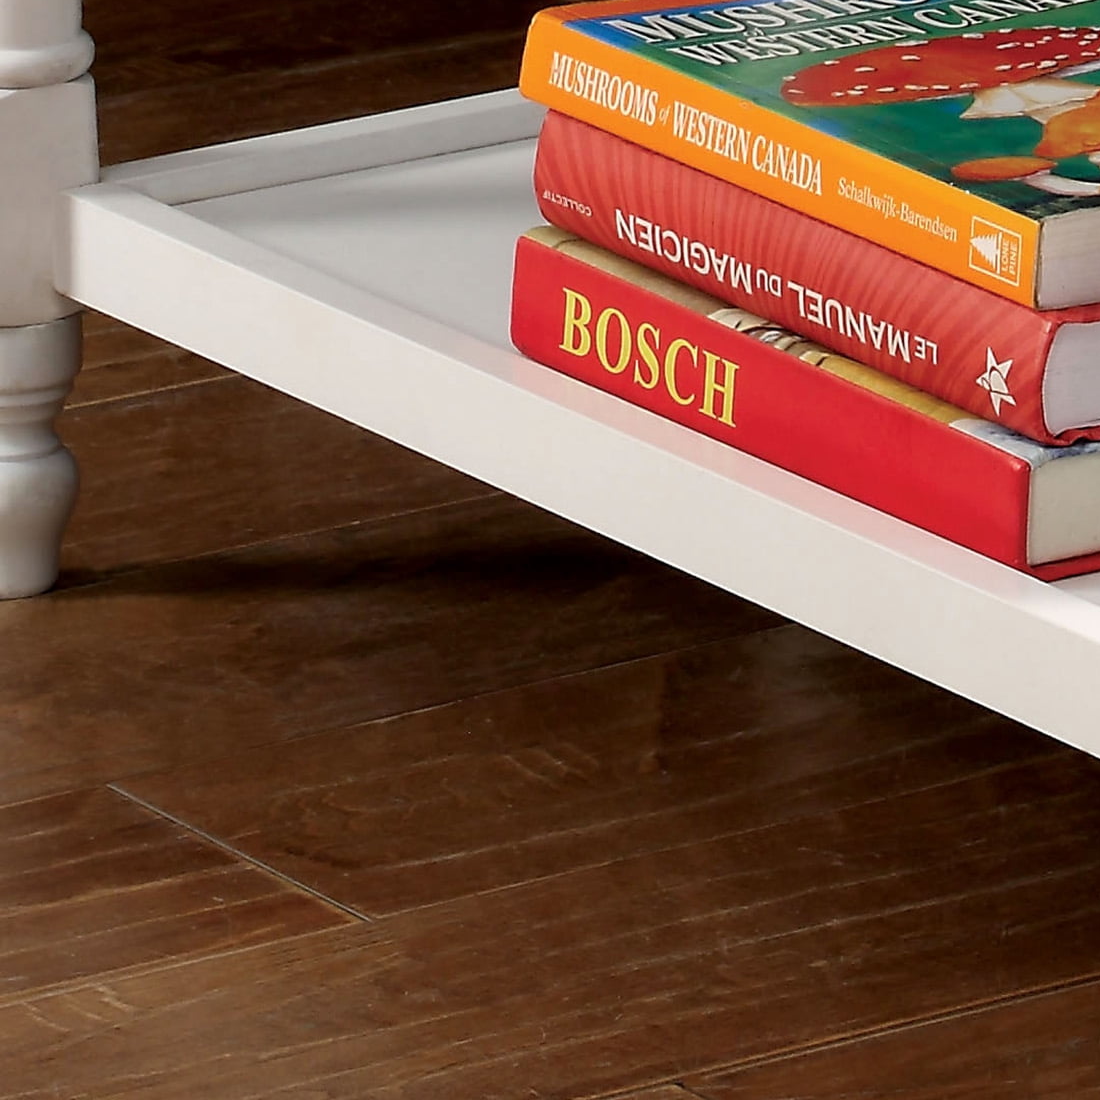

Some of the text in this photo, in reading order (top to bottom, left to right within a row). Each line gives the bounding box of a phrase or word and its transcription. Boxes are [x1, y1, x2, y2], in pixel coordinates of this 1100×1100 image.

[665, 15, 927, 65] WESTERN
[548, 51, 823, 196] MUSHROOMS of WESTERN CANADA
[542, 189, 592, 217] COLLECTIF
[837, 176, 957, 242] Schalkwijk-Barendsen
[1001, 238, 1010, 271] LONE
[1008, 240, 1018, 275] PINE
[614, 208, 938, 365] LE MANUEL DU MAGICIEN
[559, 287, 740, 428] BOSCH
